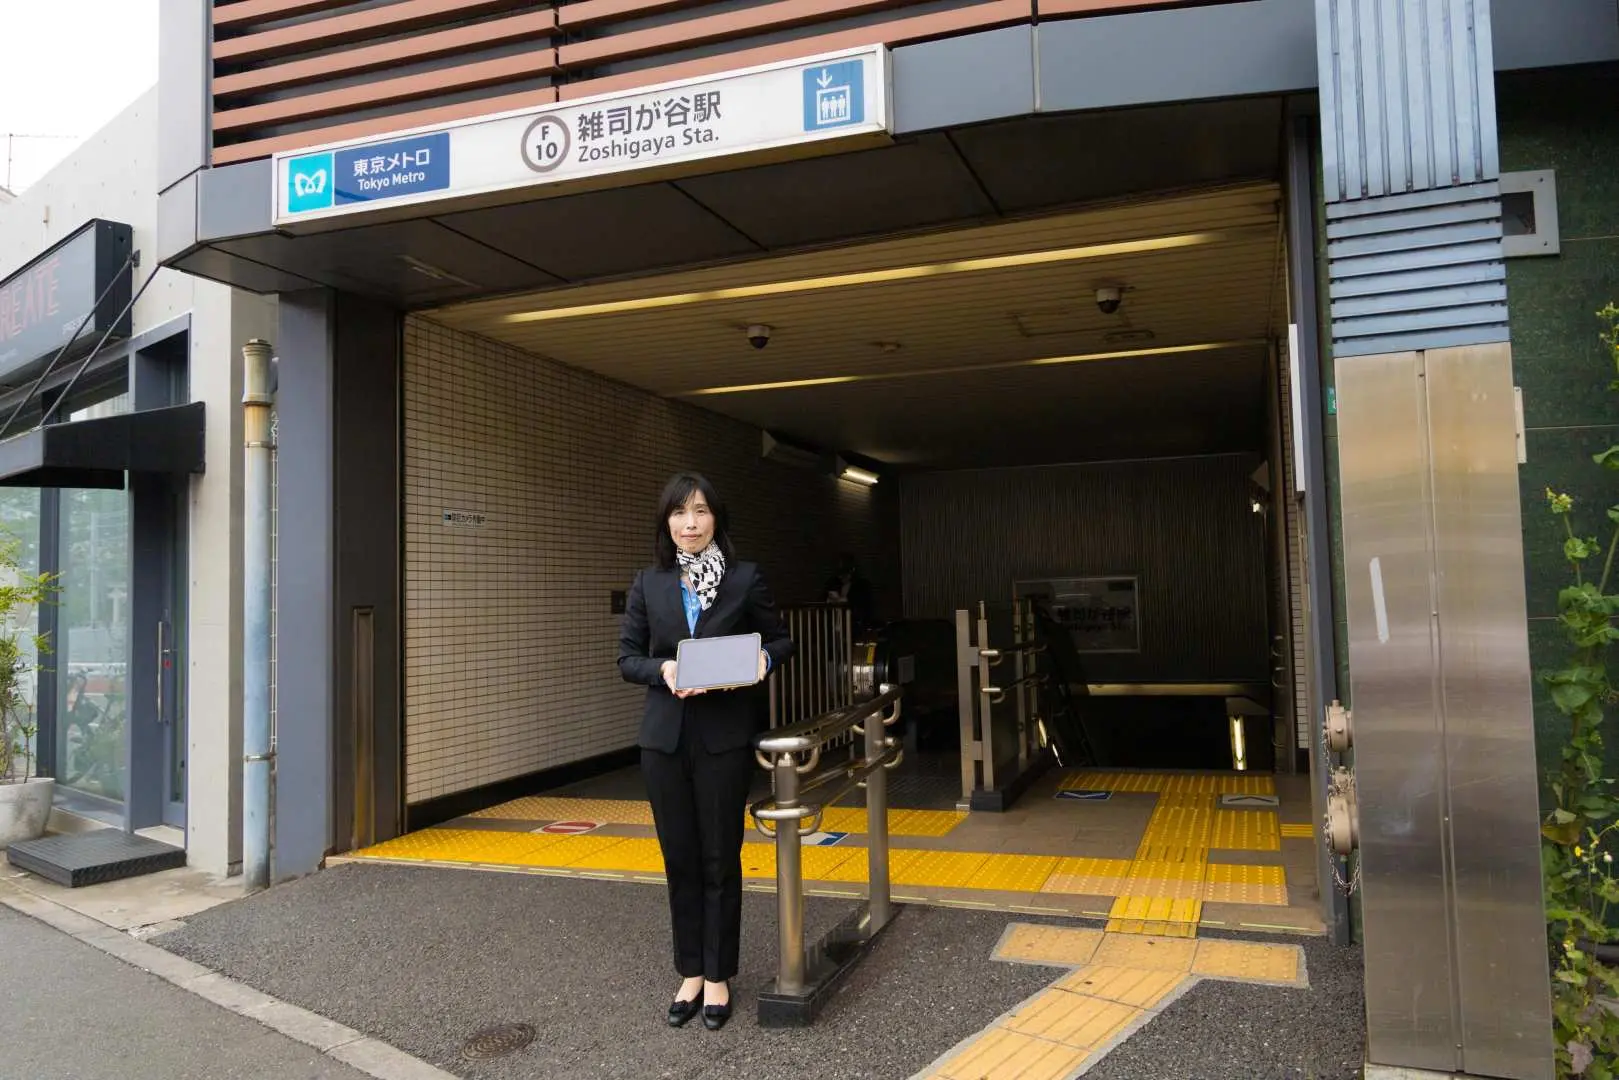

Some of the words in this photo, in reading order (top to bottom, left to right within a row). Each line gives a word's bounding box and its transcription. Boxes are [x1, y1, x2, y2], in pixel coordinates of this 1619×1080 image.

[578, 90, 722, 142] 雑司が谷駅
[541, 125, 550, 141] F
[578, 134, 676, 162] Zoshigaya
[682, 127, 719, 146] Sta.
[353, 148, 430, 177] 東京メトロ
[535, 142, 558, 161] 10
[357, 177, 390, 191] Tokyo
[392, 171, 425, 186] Metro
